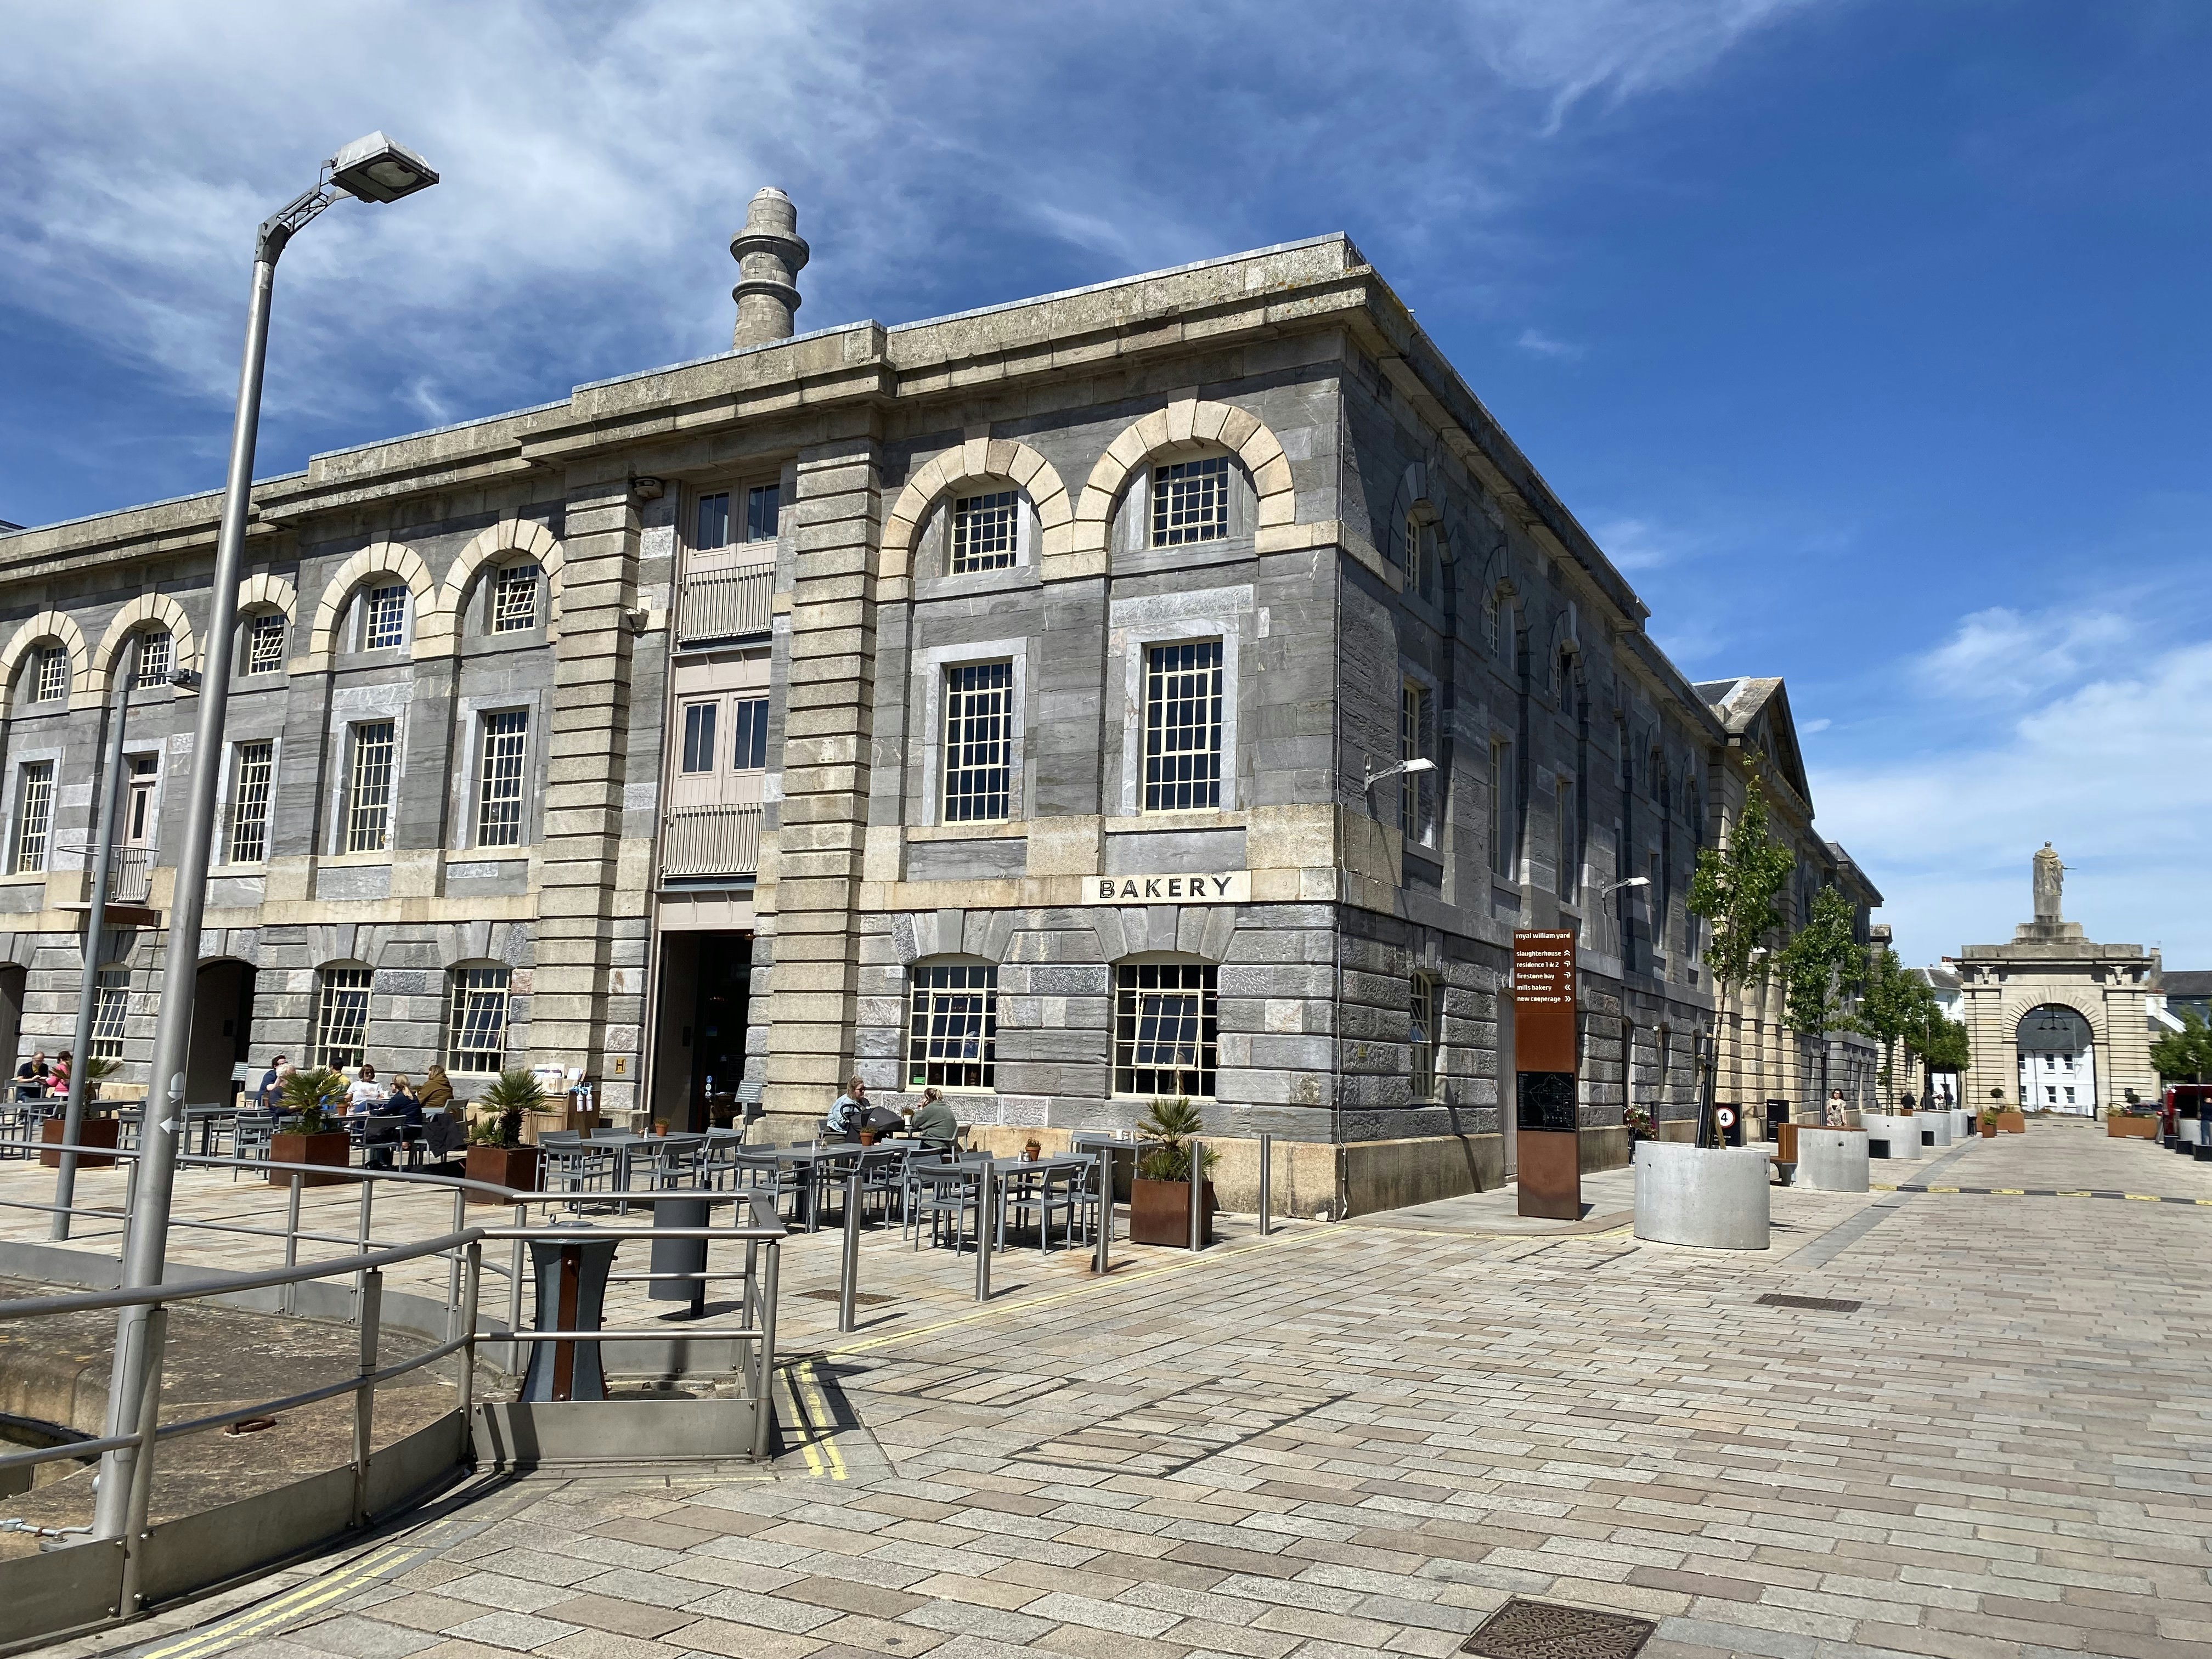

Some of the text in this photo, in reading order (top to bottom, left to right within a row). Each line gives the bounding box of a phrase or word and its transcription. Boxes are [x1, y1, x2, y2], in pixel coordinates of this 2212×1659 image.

[1099, 877, 1232, 899] BAKERY
[616, 1059, 624, 1071] H
[1720, 1113, 1728, 1122] 4
